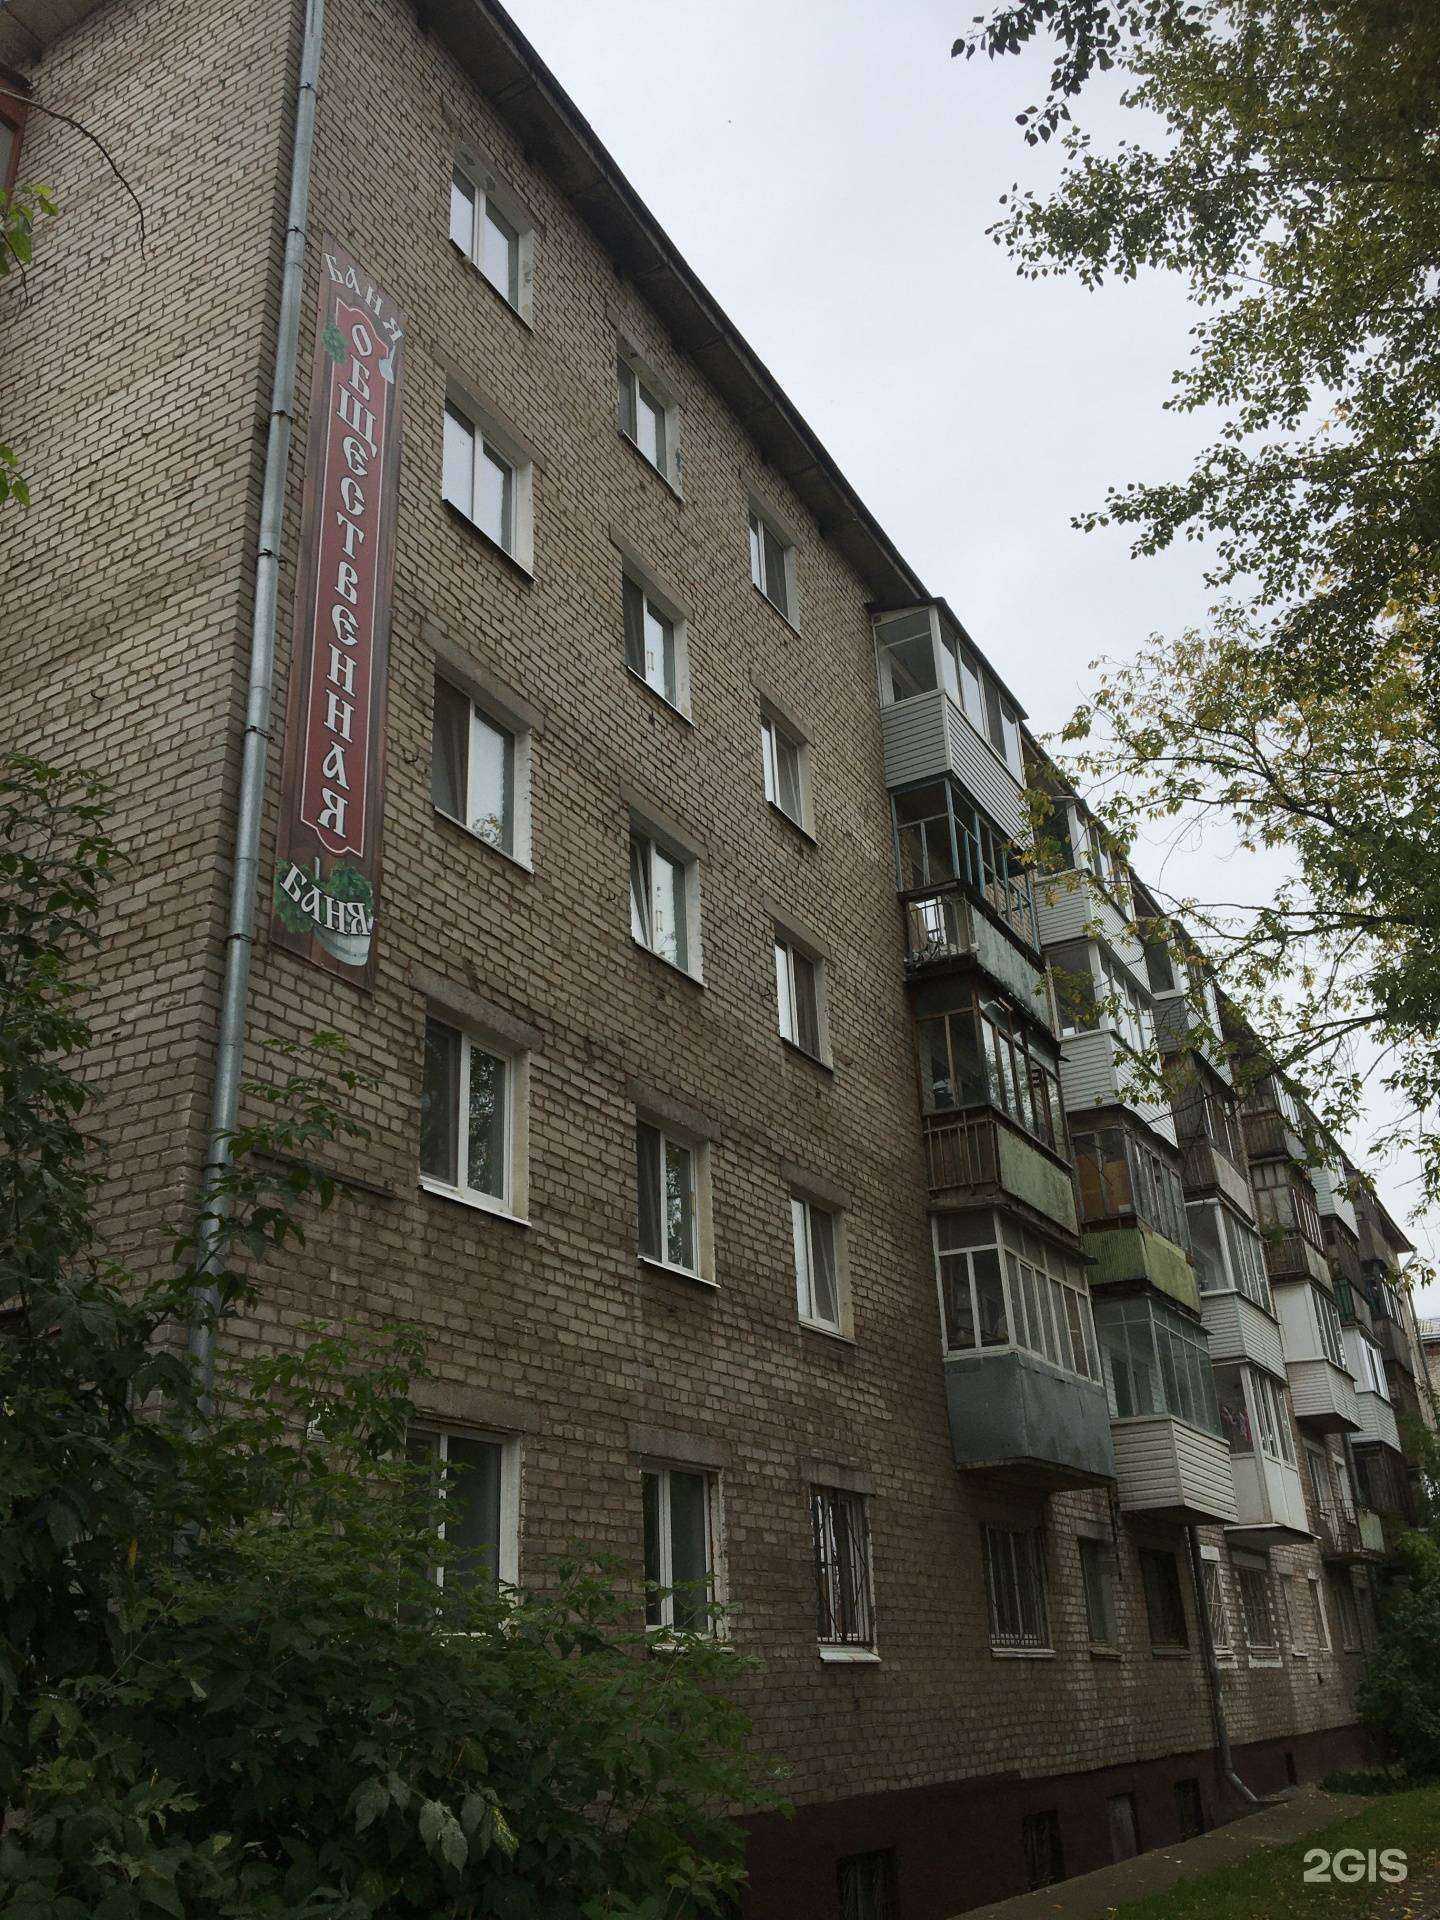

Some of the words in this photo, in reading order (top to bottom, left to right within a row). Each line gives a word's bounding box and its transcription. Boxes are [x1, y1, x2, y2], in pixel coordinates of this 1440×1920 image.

[322, 252, 404, 341] БАНЯ
[316, 323, 378, 838] ОБЩЕСТВЕННАЯ
[280, 862, 371, 935] БАНЯ
